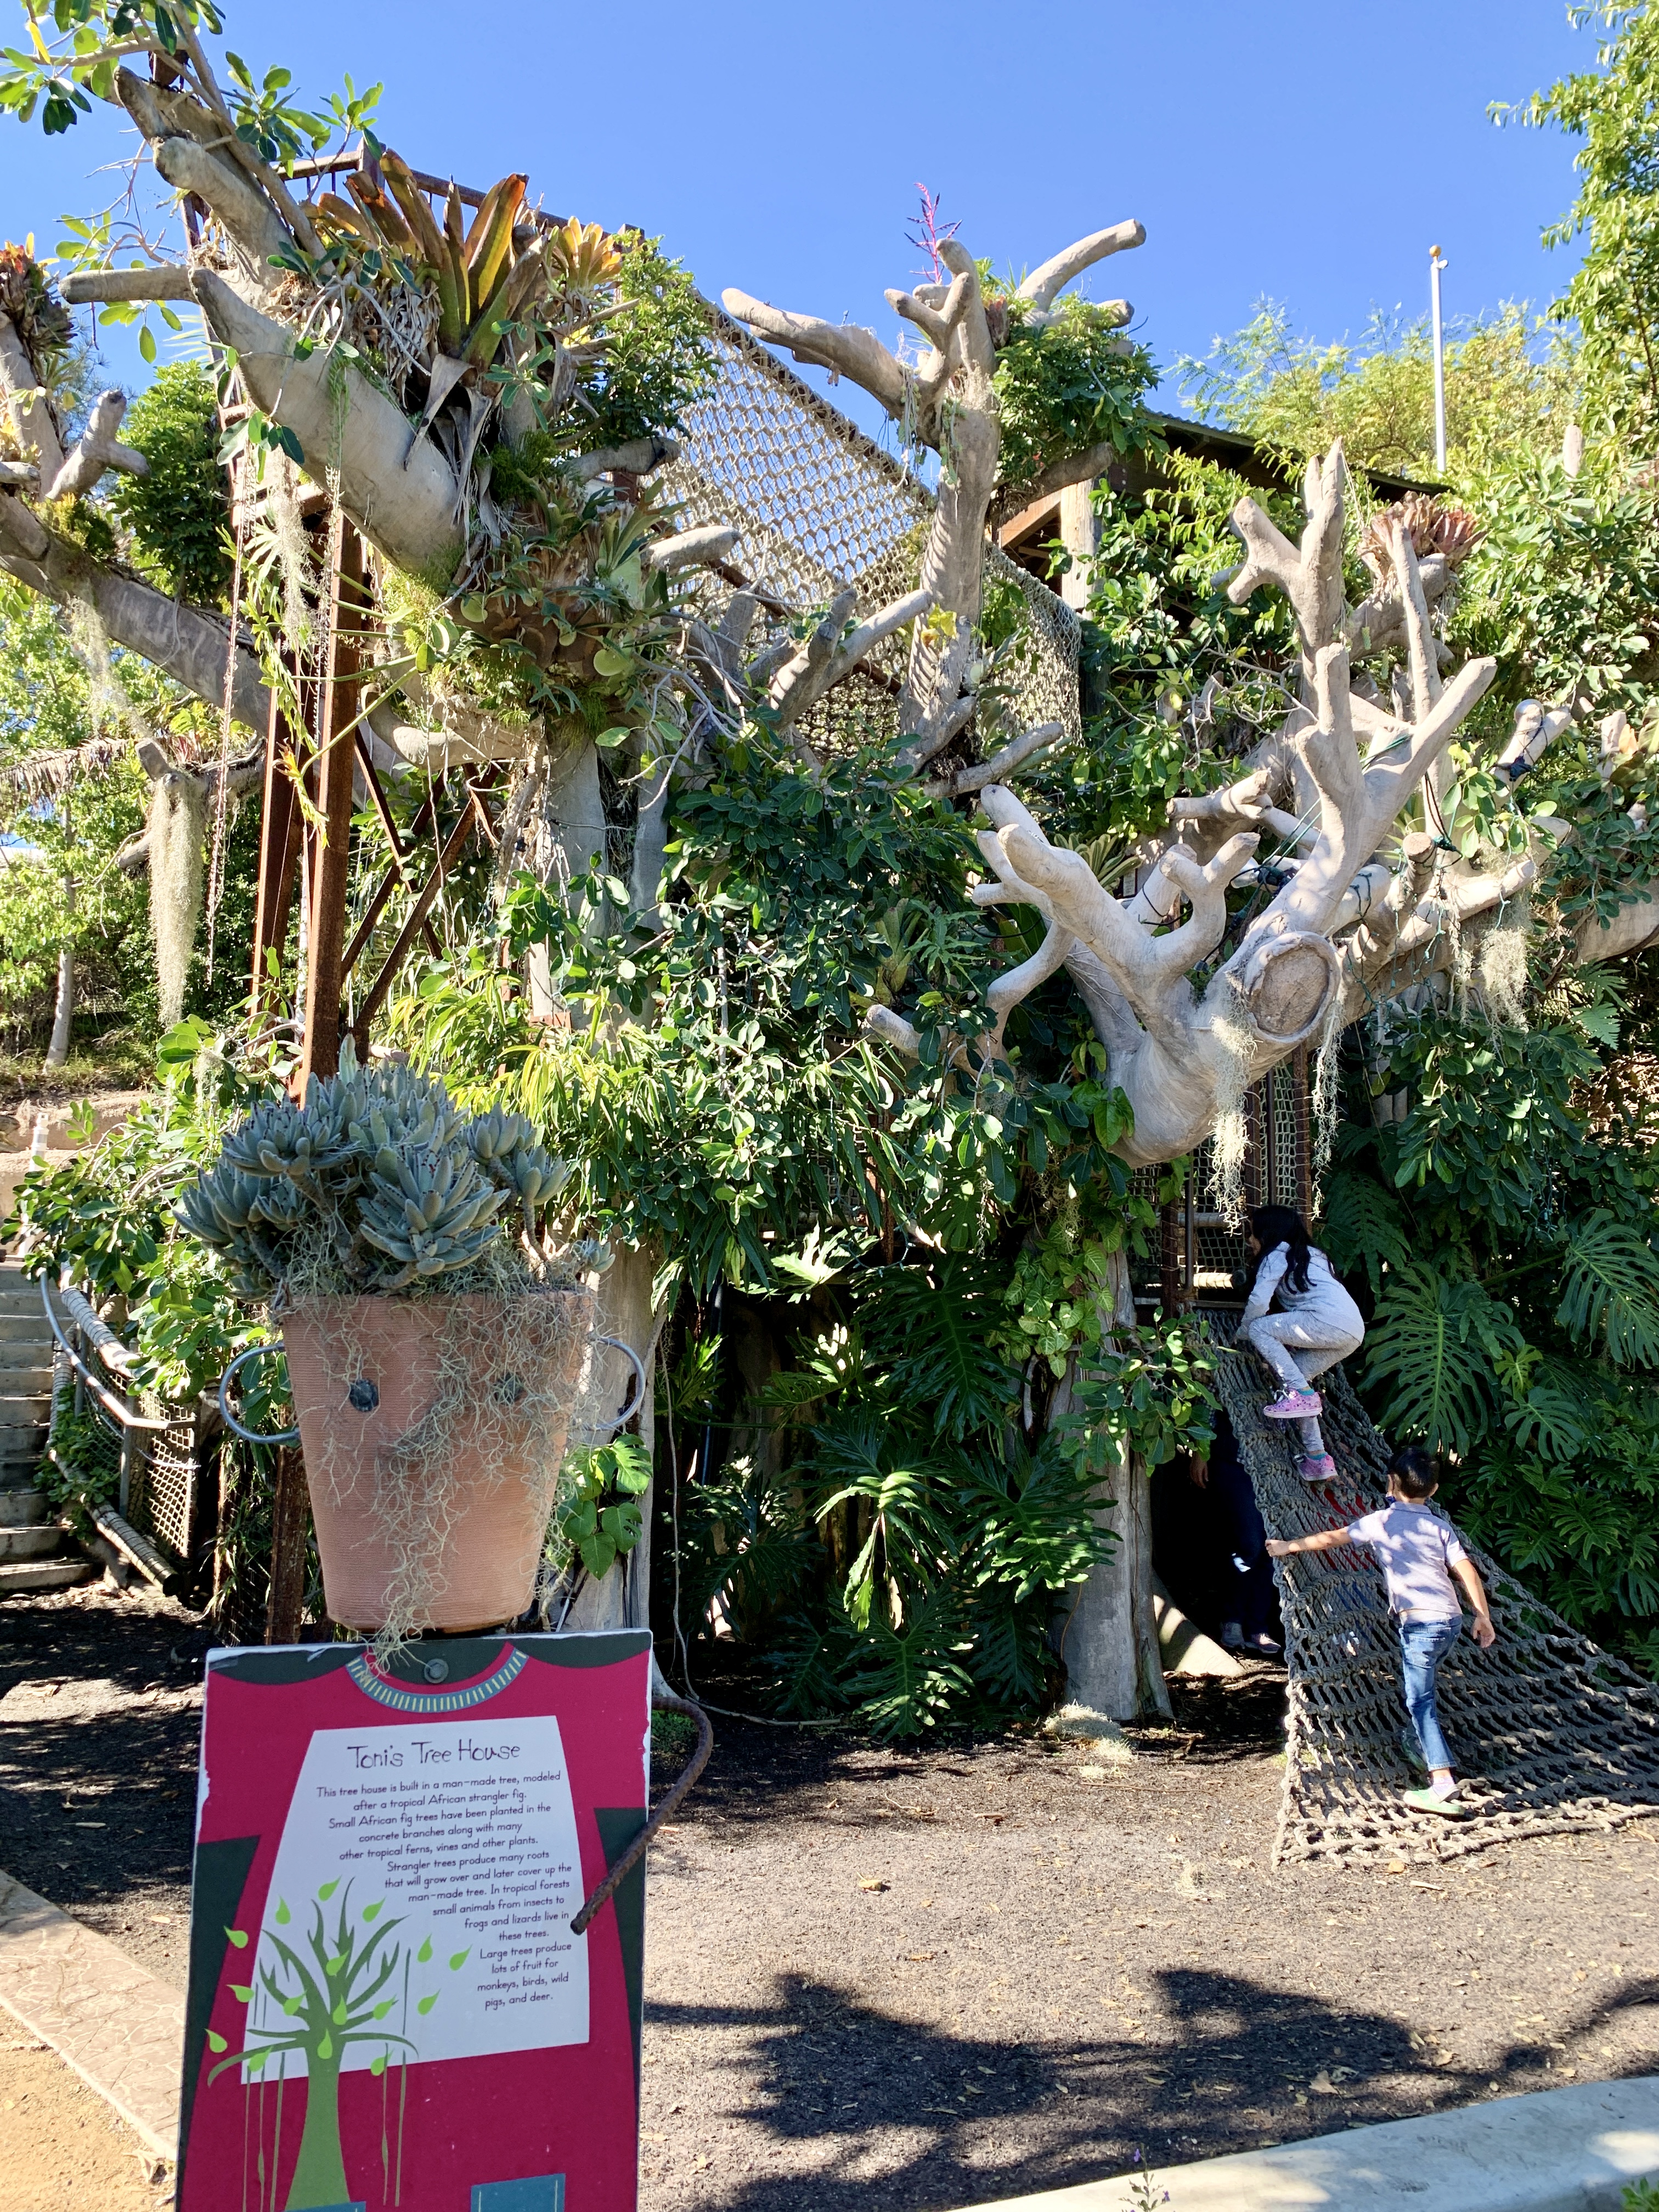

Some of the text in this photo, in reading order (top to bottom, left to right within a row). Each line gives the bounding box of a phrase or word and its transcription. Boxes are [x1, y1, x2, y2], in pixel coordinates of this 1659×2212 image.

[347, 1738, 521, 1769] Toni's Tree House
[316, 1786, 336, 1798] This
[339, 1787, 358, 1796] tree
[361, 1784, 387, 1794] house
[390, 1784, 397, 1792] is
[399, 1780, 419, 1792] built
[422, 1781, 430, 1790] in
[442, 1775, 496, 1788] man-made
[499, 1776, 520, 1785] tree,
[523, 1770, 561, 1782] modeled
[353, 1799, 377, 1811] after
[390, 1795, 426, 1812] tropical
[427, 1793, 466, 1805] African
[469, 1790, 510, 1805] strangler
[512, 1788, 527, 1803] fig.
[329, 1802, 551, 1829] Small African fig trees have been planted in the
[359, 1821, 523, 1843] concrete branches along with many
[339, 1835, 538, 1861] other tropical ferns, vines and other plants.
[387, 1850, 550, 1875] Strangler trees produce many roots
[385, 1877, 403, 1888] that
[406, 1875, 421, 1886] will
[424, 1877, 448, 1889] grow
[472, 1868, 491, 1881] and
[493, 1868, 515, 1878] later
[545, 1867, 556, 1878] up
[558, 1861, 572, 1872] the
[408, 1879, 570, 1902] man-made tree. In tropical forests
[432, 1895, 565, 1916] small animals from insects to
[464, 1910, 569, 1932] frogs and lizards live in
[499, 1930, 549, 1941] these trees.
[480, 1940, 572, 1962] Large trees produce
[492, 1957, 558, 1974] lots of fruit for
[477, 1971, 569, 1993] monkeys, birds, wild
[485, 1991, 553, 2011] pigs, and deer.
